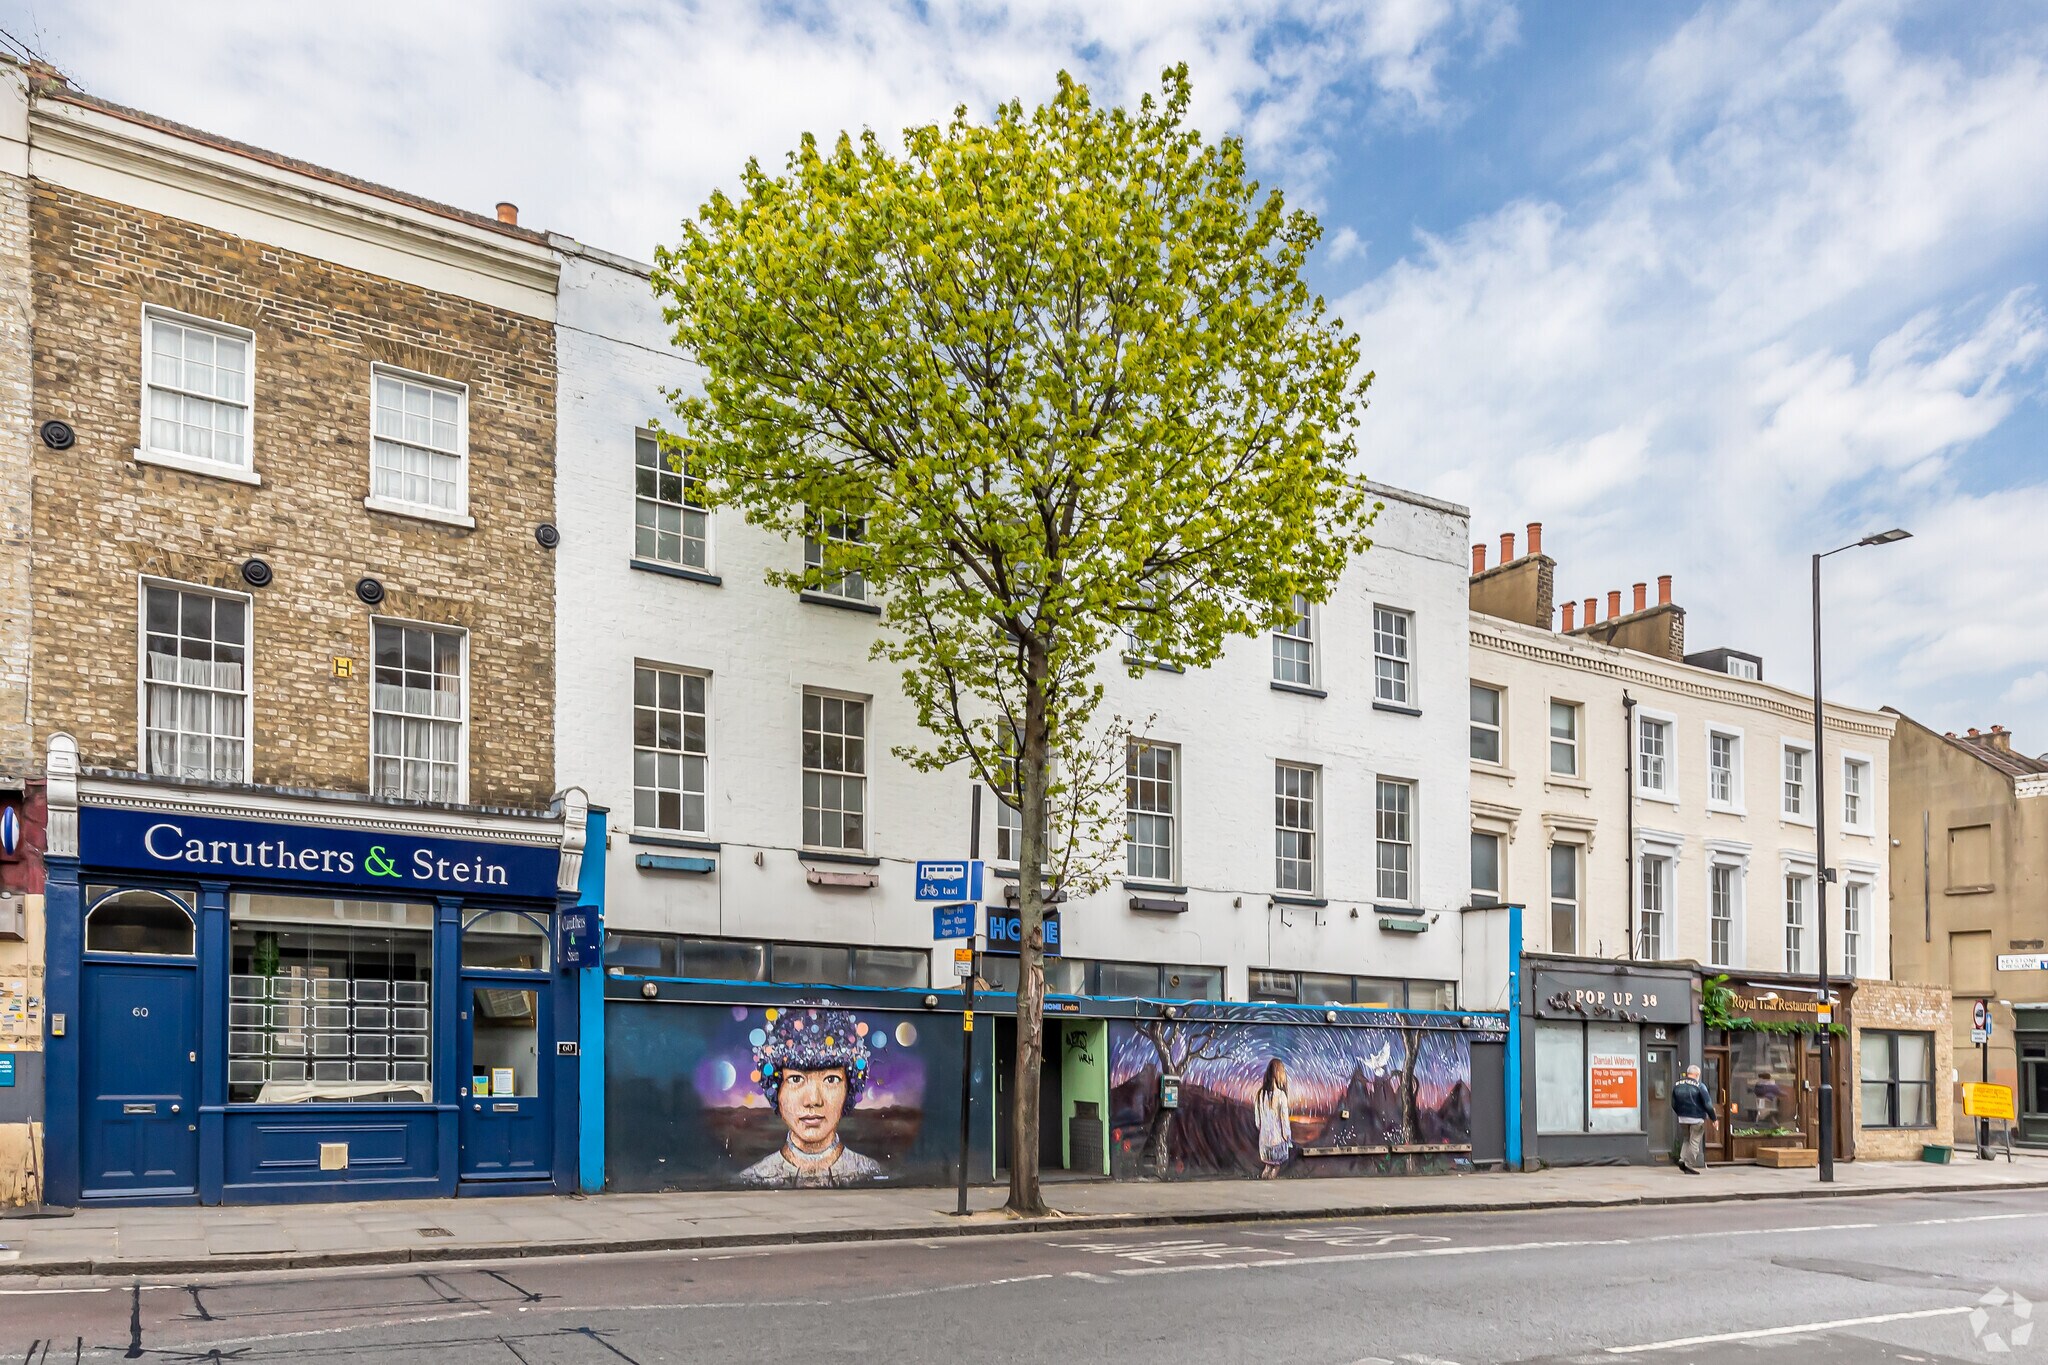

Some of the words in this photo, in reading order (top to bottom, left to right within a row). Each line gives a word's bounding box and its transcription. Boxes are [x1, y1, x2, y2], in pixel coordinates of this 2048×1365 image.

[144, 823, 354, 874] Caruthers
[364, 845, 402, 878] &
[412, 849, 509, 886] Stein
[943, 886, 958, 895] taxi
[990, 917, 1058, 944] HOE
[1575, 989, 1605, 1005] POP
[1613, 992, 1633, 1006] UP
[1641, 994, 1658, 1008] 38
[1732, 994, 1756, 1012] Royal
[1778, 997, 1819, 1013] Restauran
[132, 1007, 149, 1017] 60
[1043, 1003, 1062, 1011] HOME
[1062, 1003, 1079, 1012] London
[1655, 1028, 1667, 1040] 52
[562, 1043, 573, 1052] 60
